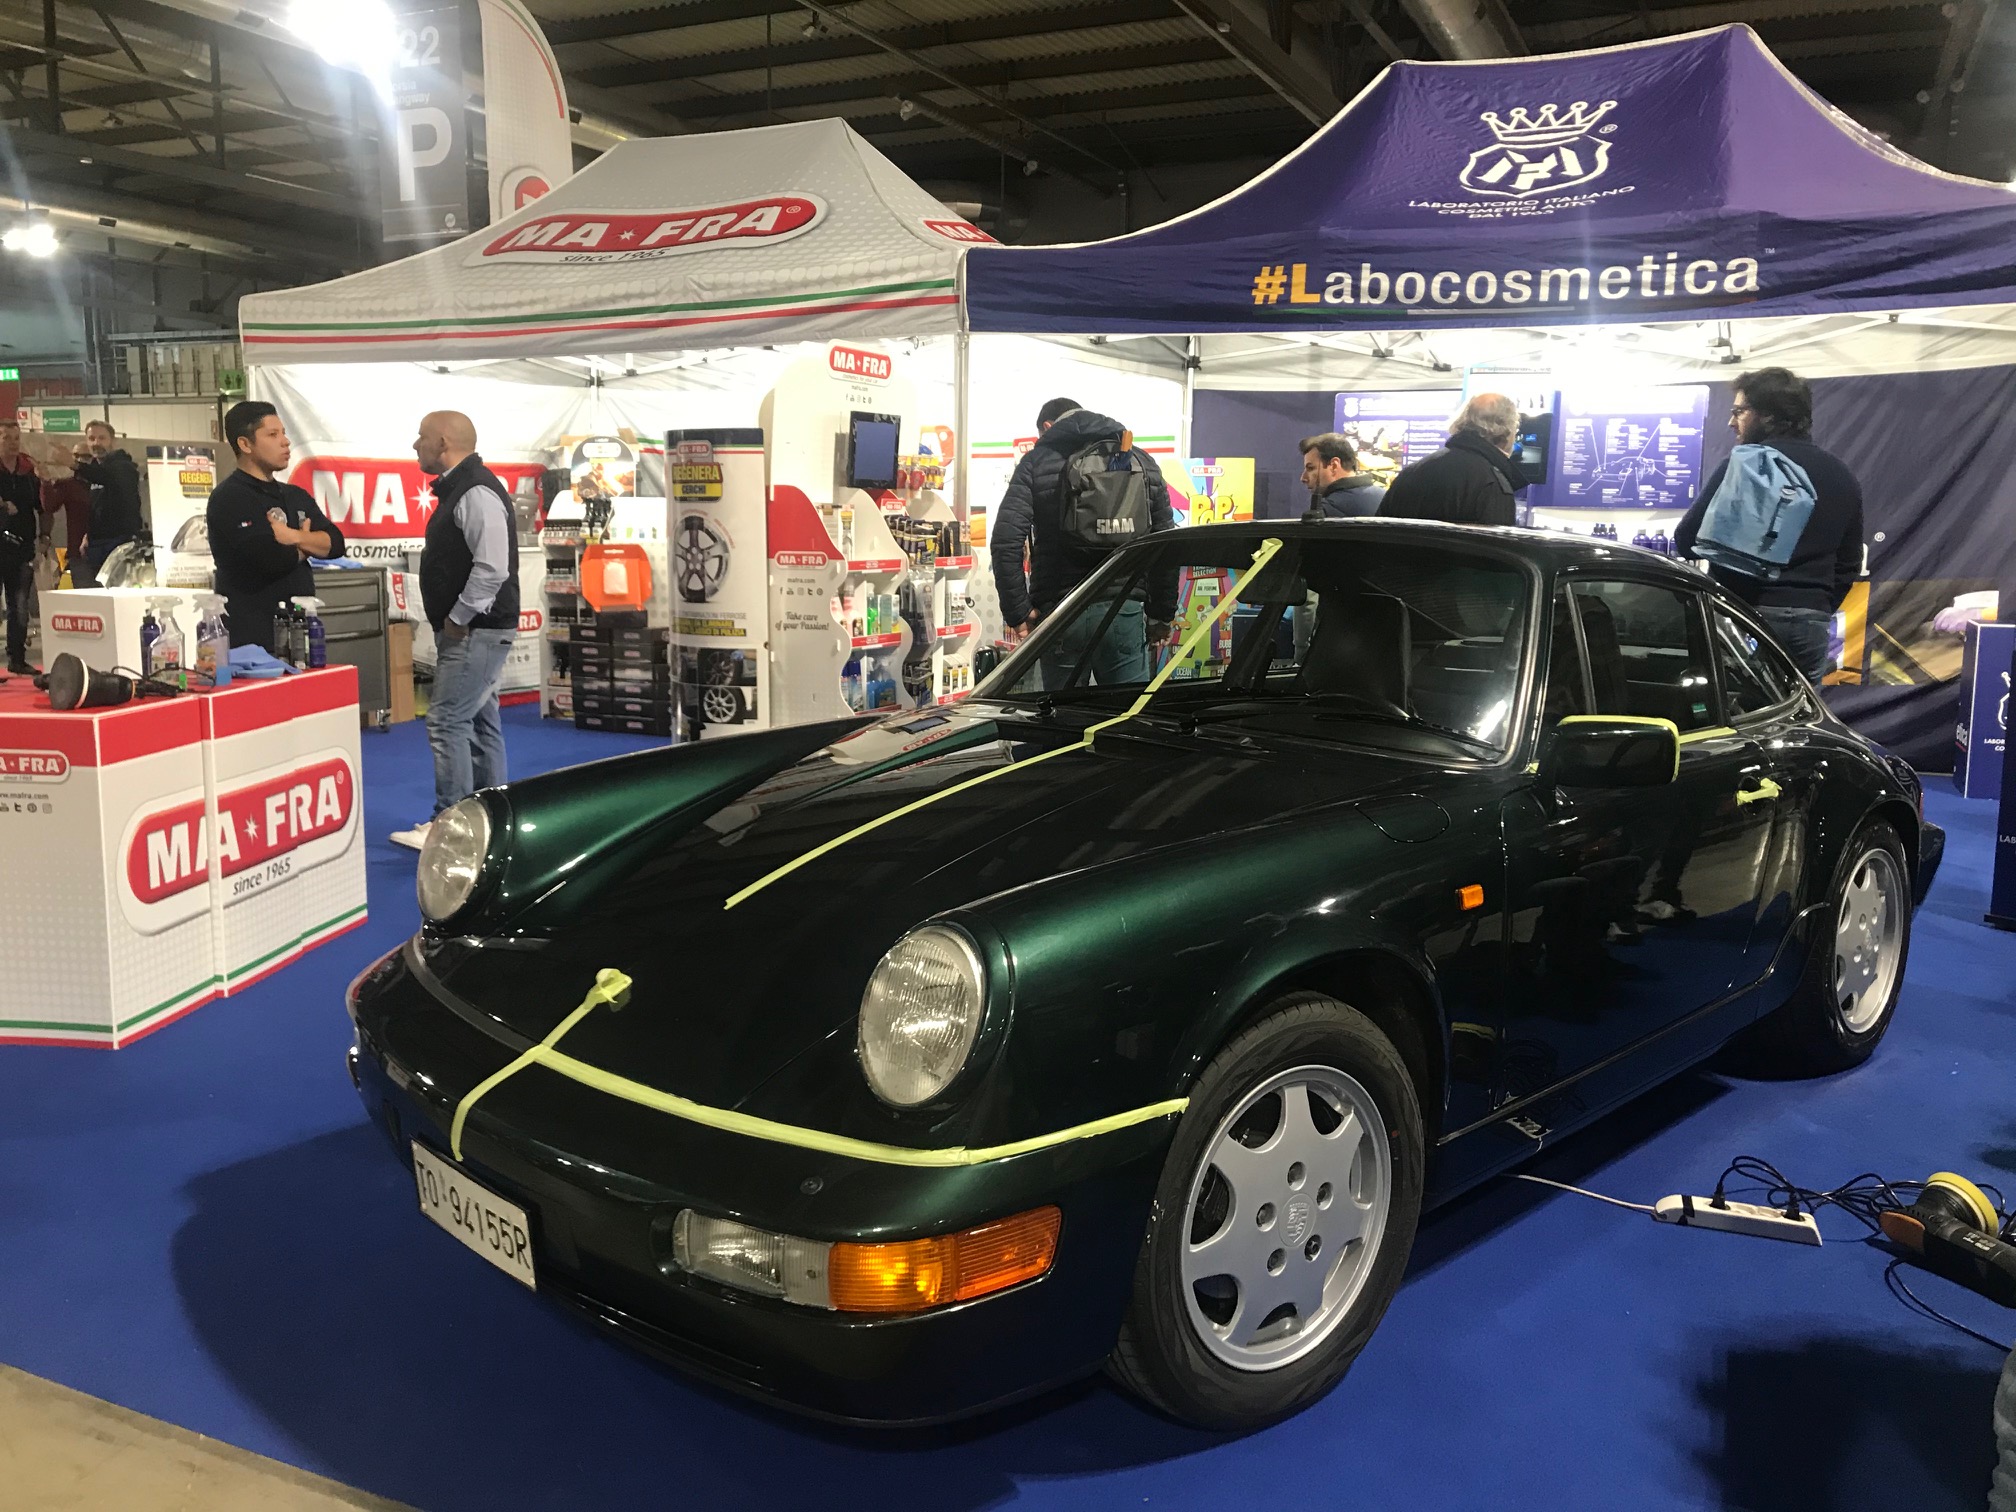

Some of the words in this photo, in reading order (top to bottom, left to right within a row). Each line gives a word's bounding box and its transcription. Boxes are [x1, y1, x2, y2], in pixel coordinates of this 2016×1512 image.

[397, 107, 452, 202] P
[1408, 199, 1540, 209] LABORATORIO
[1545, 185, 1635, 205] ITALIANO
[1438, 205, 1538, 215] COSMETICI
[1541, 199, 1596, 210] AUTO
[559, 252, 613, 263] since
[617, 248, 671, 262] 1965
[1252, 251, 1760, 305] #Labocosmetica
[1096, 518, 1135, 535] SLAM
[785, 611, 802, 621] Take
[775, 620, 783, 631] of
[782, 623, 799, 631] your
[1176, 667, 1192, 676] OCEAN
[232, 870, 263, 896] since
[265, 856, 292, 883] 1965
[449, 1185, 531, 1271] 94155R
